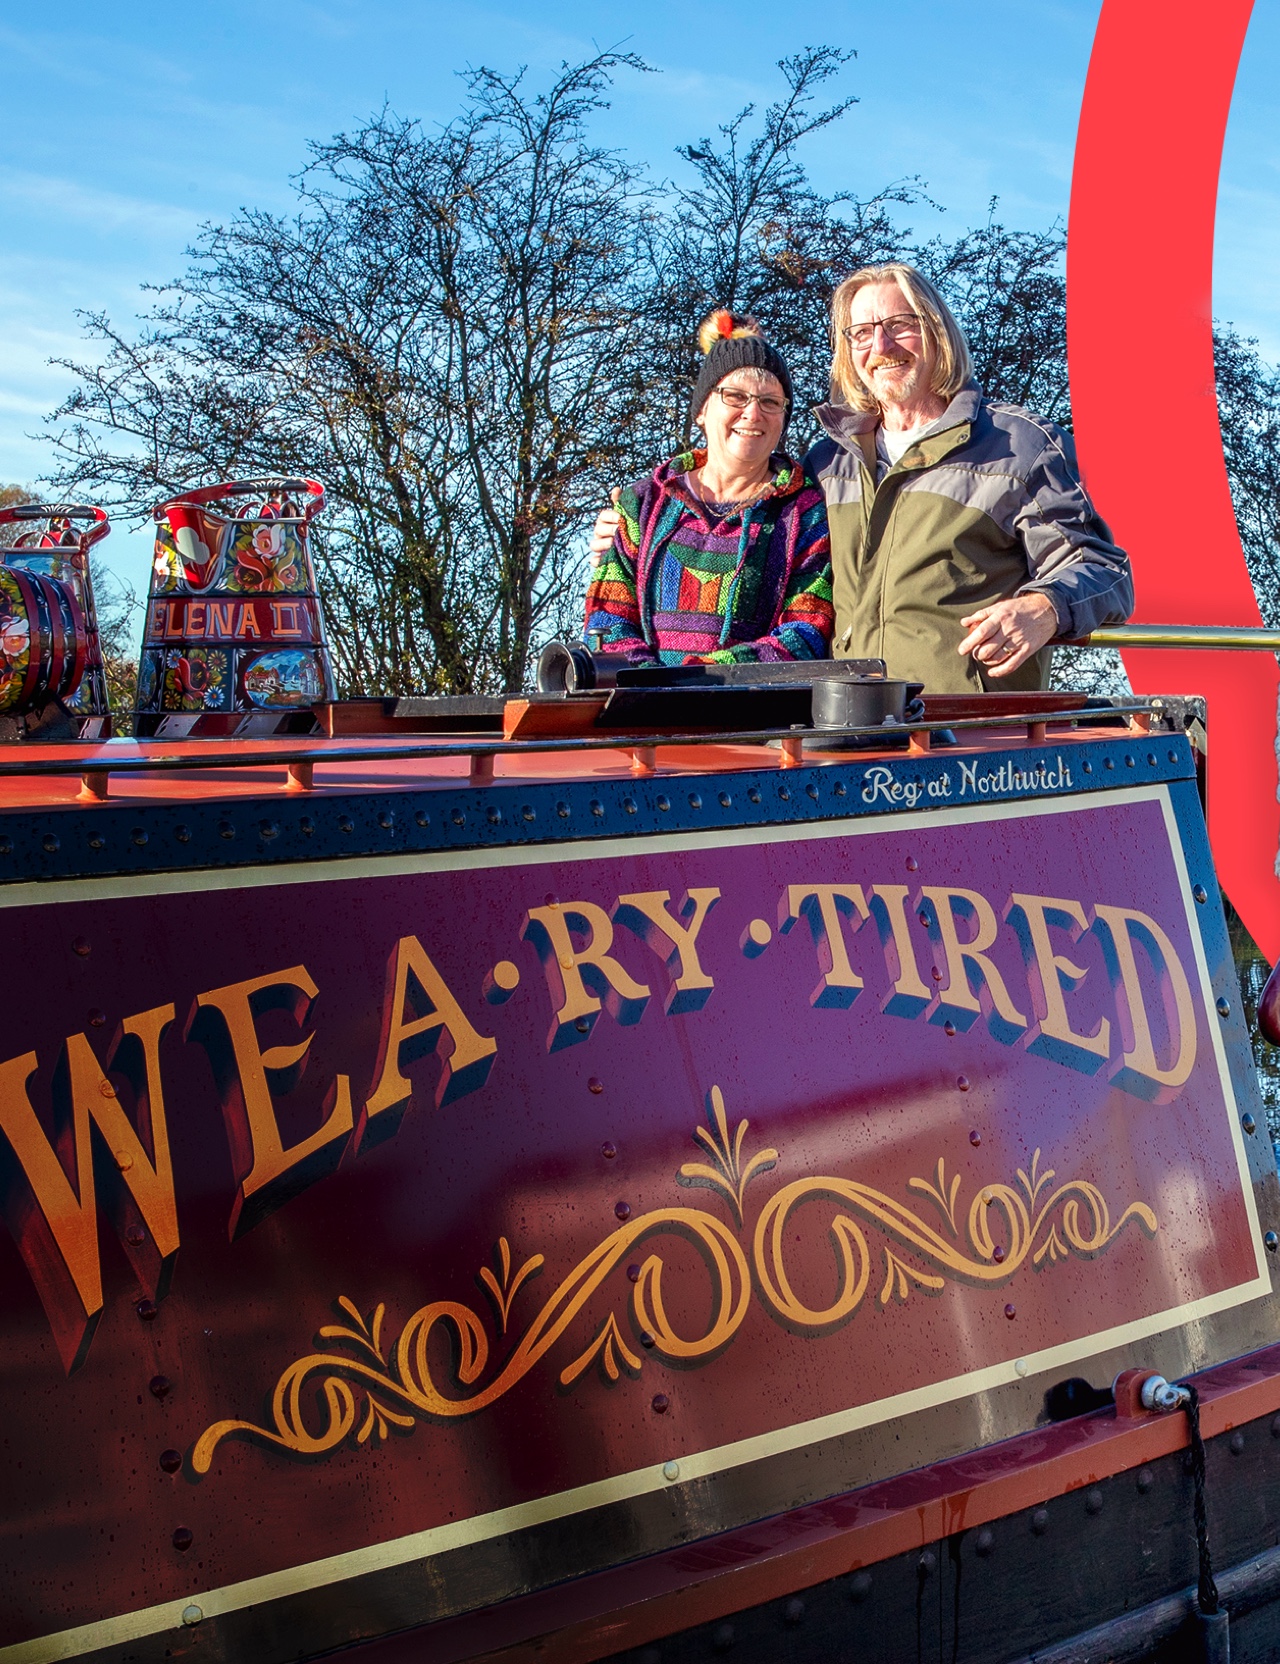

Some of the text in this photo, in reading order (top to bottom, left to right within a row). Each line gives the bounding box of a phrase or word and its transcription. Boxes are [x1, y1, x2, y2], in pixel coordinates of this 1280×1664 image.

[861, 755, 1074, 808] Reg at Northwich
[787, 883, 1198, 1088] TIRED
